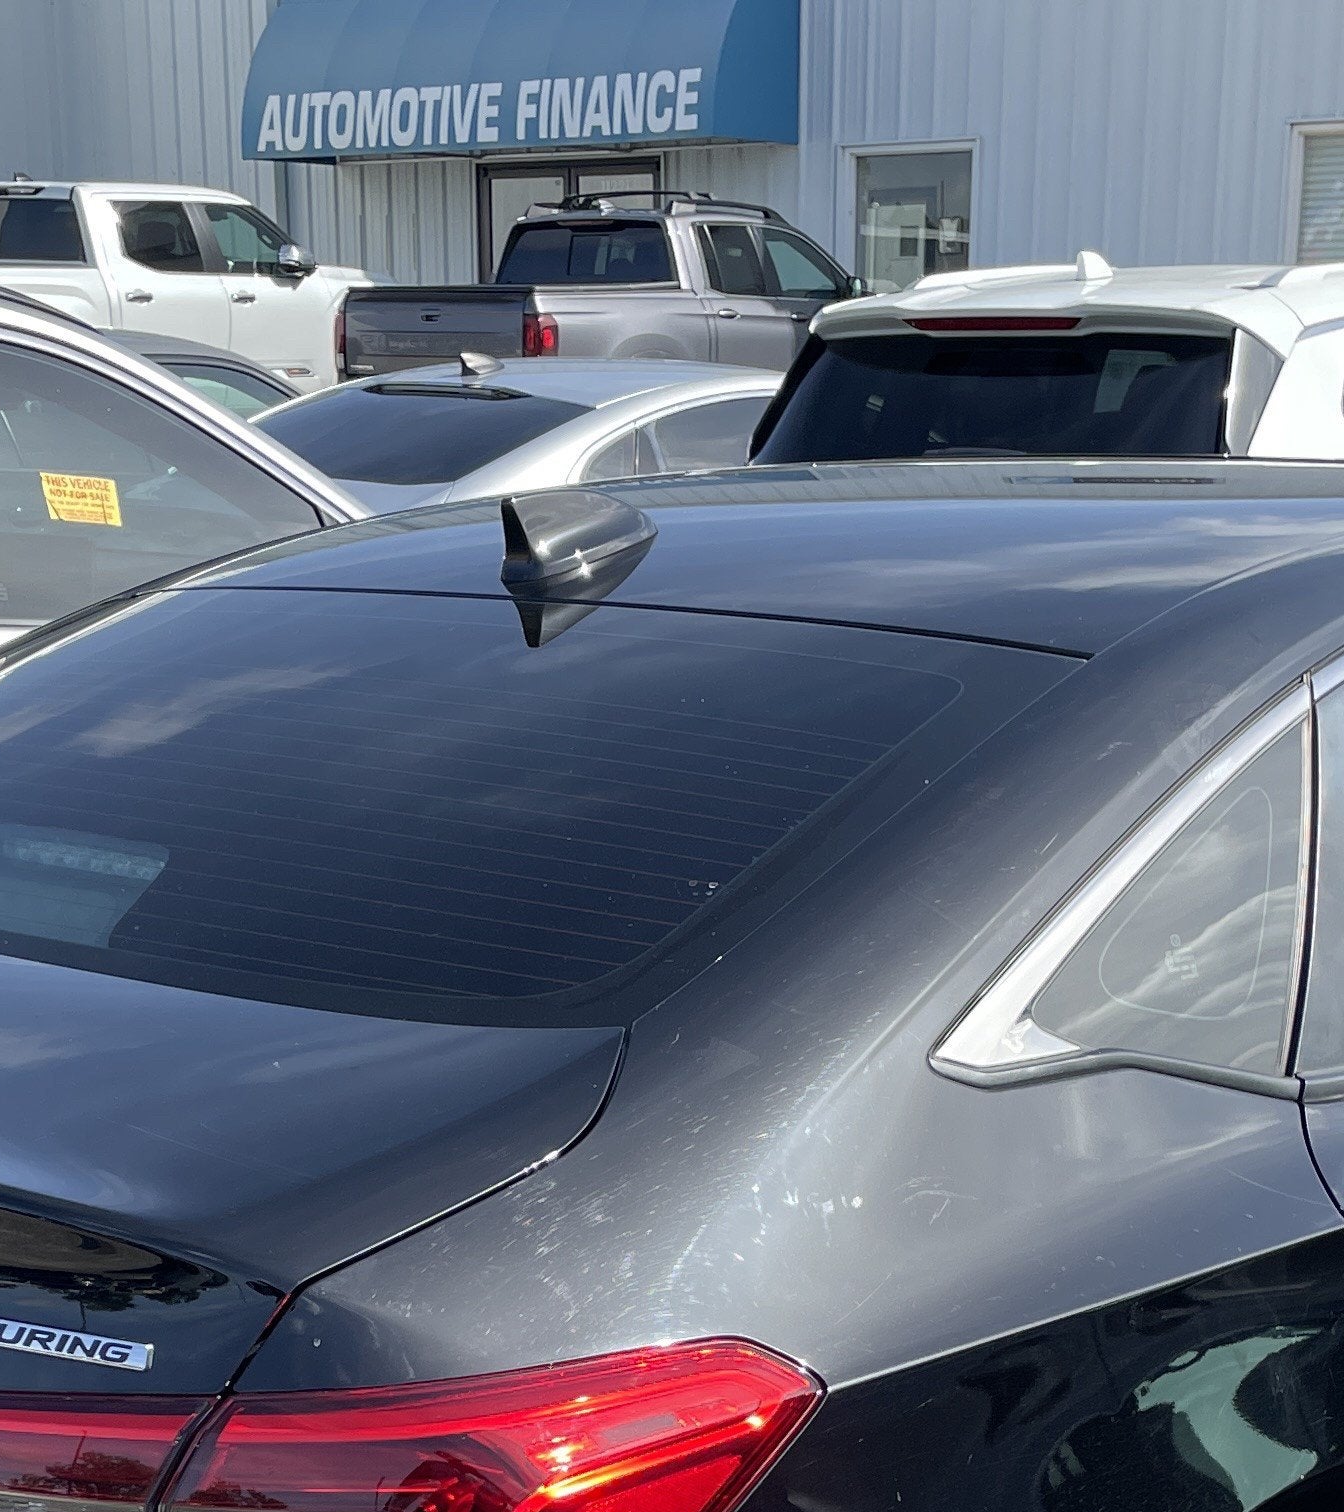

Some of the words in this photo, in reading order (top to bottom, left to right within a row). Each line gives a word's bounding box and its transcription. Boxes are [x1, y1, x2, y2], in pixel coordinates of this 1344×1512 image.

[258, 82, 502, 152] AUTOMOTIVE
[516, 67, 702, 140] FINANCE
[45, 475, 68, 487] THIS
[69, 478, 111, 492] VEHICLE
[49, 488, 67, 498] NOT
[68, 490, 87, 500] FOR
[89, 492, 110, 502] SALE
